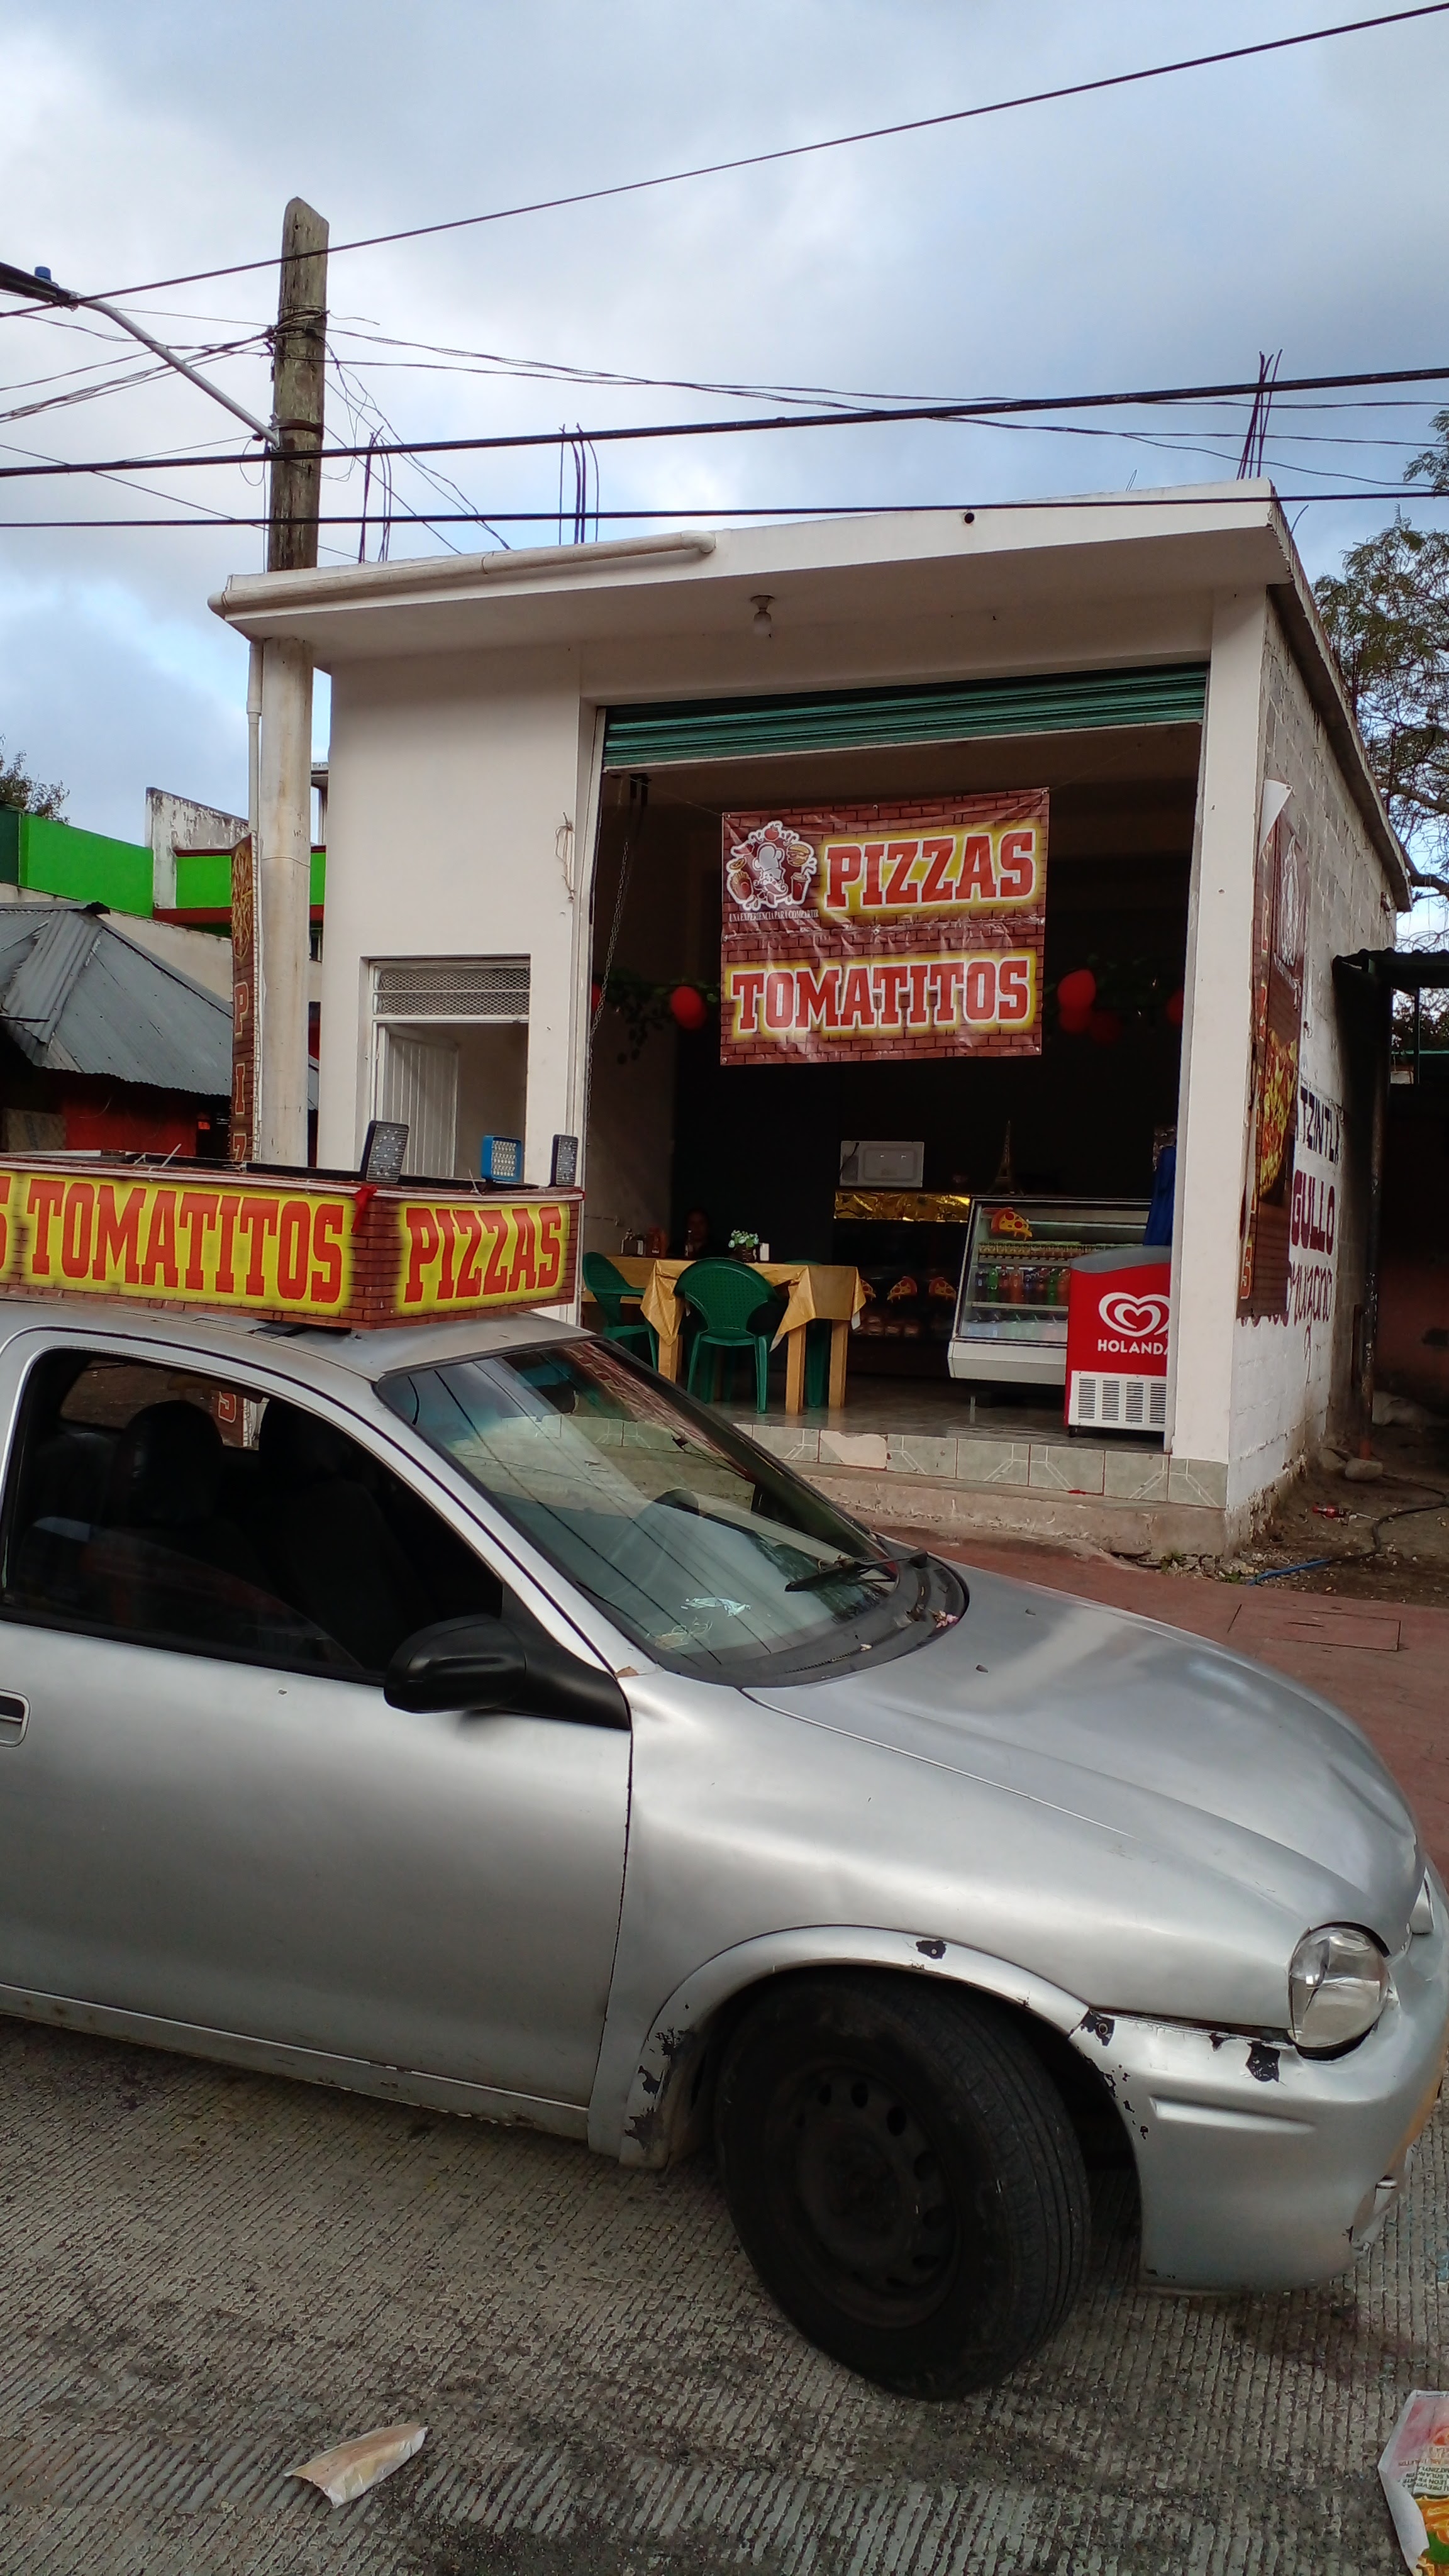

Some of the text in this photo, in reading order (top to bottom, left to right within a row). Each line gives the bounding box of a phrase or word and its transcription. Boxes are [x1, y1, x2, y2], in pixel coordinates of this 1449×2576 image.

[823, 828, 1036, 912] PIZZAS
[730, 955, 1031, 1035] TOMATITOS
[26, 1178, 345, 1304] TOMATITOS
[402, 1205, 563, 1304] PIZZAS
